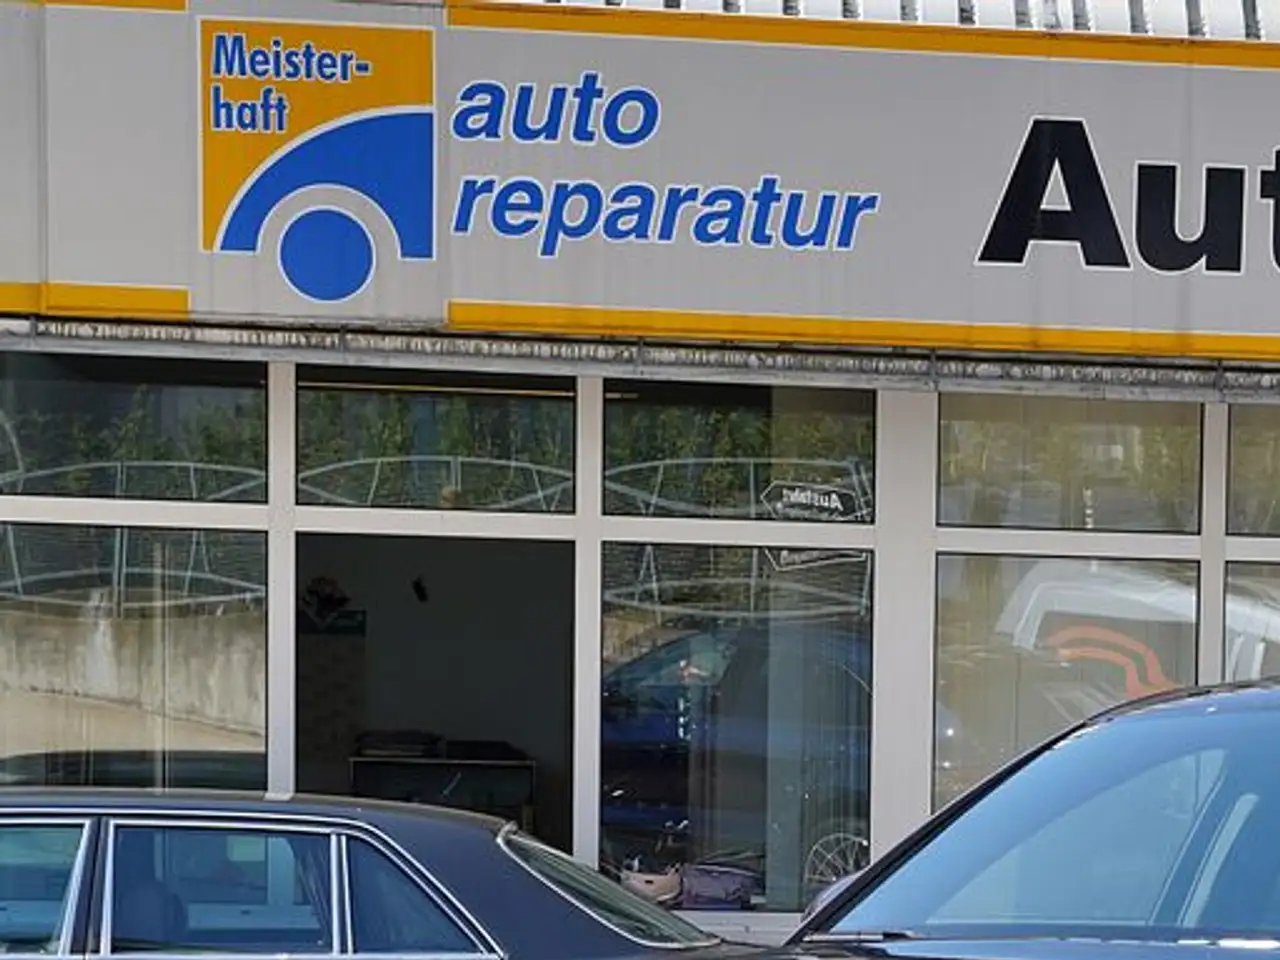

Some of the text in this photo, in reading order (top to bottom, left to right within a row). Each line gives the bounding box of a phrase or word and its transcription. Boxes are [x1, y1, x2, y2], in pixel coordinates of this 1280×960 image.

[210, 34, 371, 82] Meister-
[211, 85, 289, 132] haft
[452, 71, 660, 148] auto
[452, 175, 879, 259] reparatur
